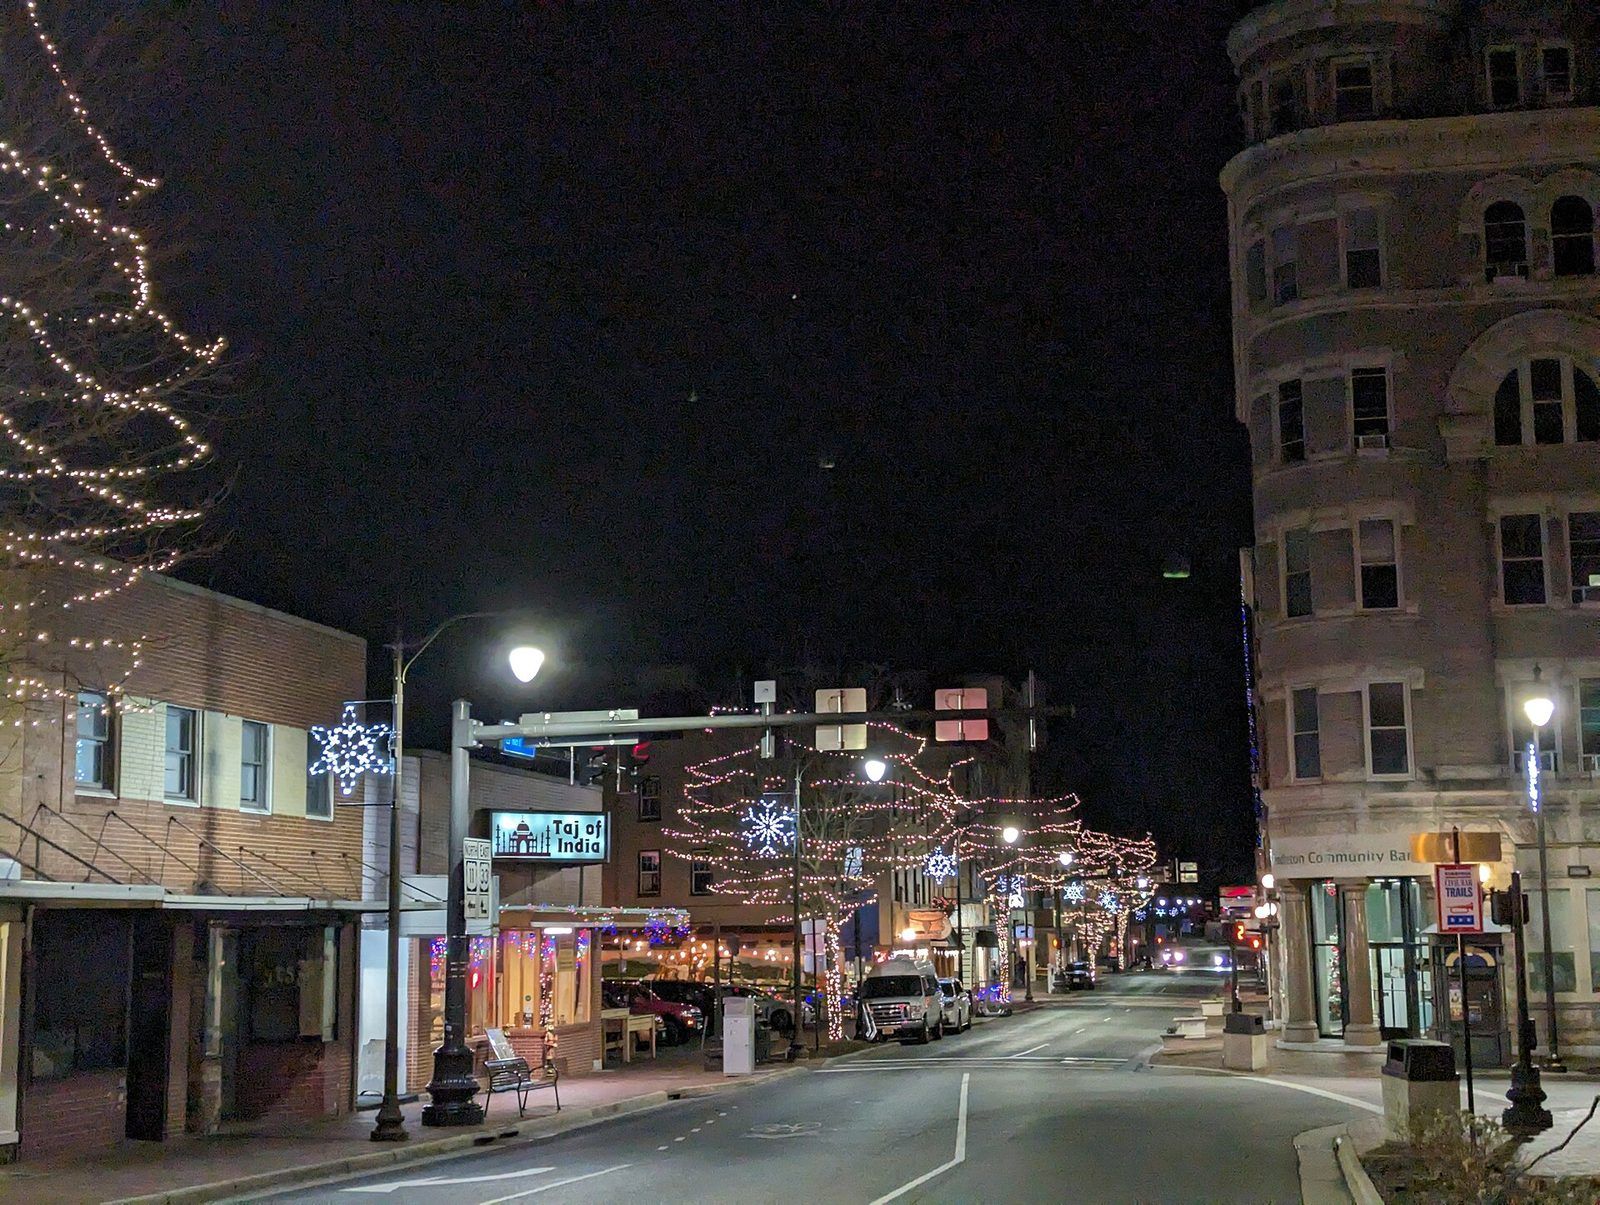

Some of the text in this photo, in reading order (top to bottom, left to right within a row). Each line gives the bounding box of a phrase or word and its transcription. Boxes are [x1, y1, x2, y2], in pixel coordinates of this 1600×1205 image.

[553, 820, 602, 839] Taj of
[480, 845, 489, 858] EAST
[558, 838, 600, 853] India
[469, 868, 475, 883] 11
[481, 869, 488, 884] 33
[1445, 887, 1473, 897] TRAILS
